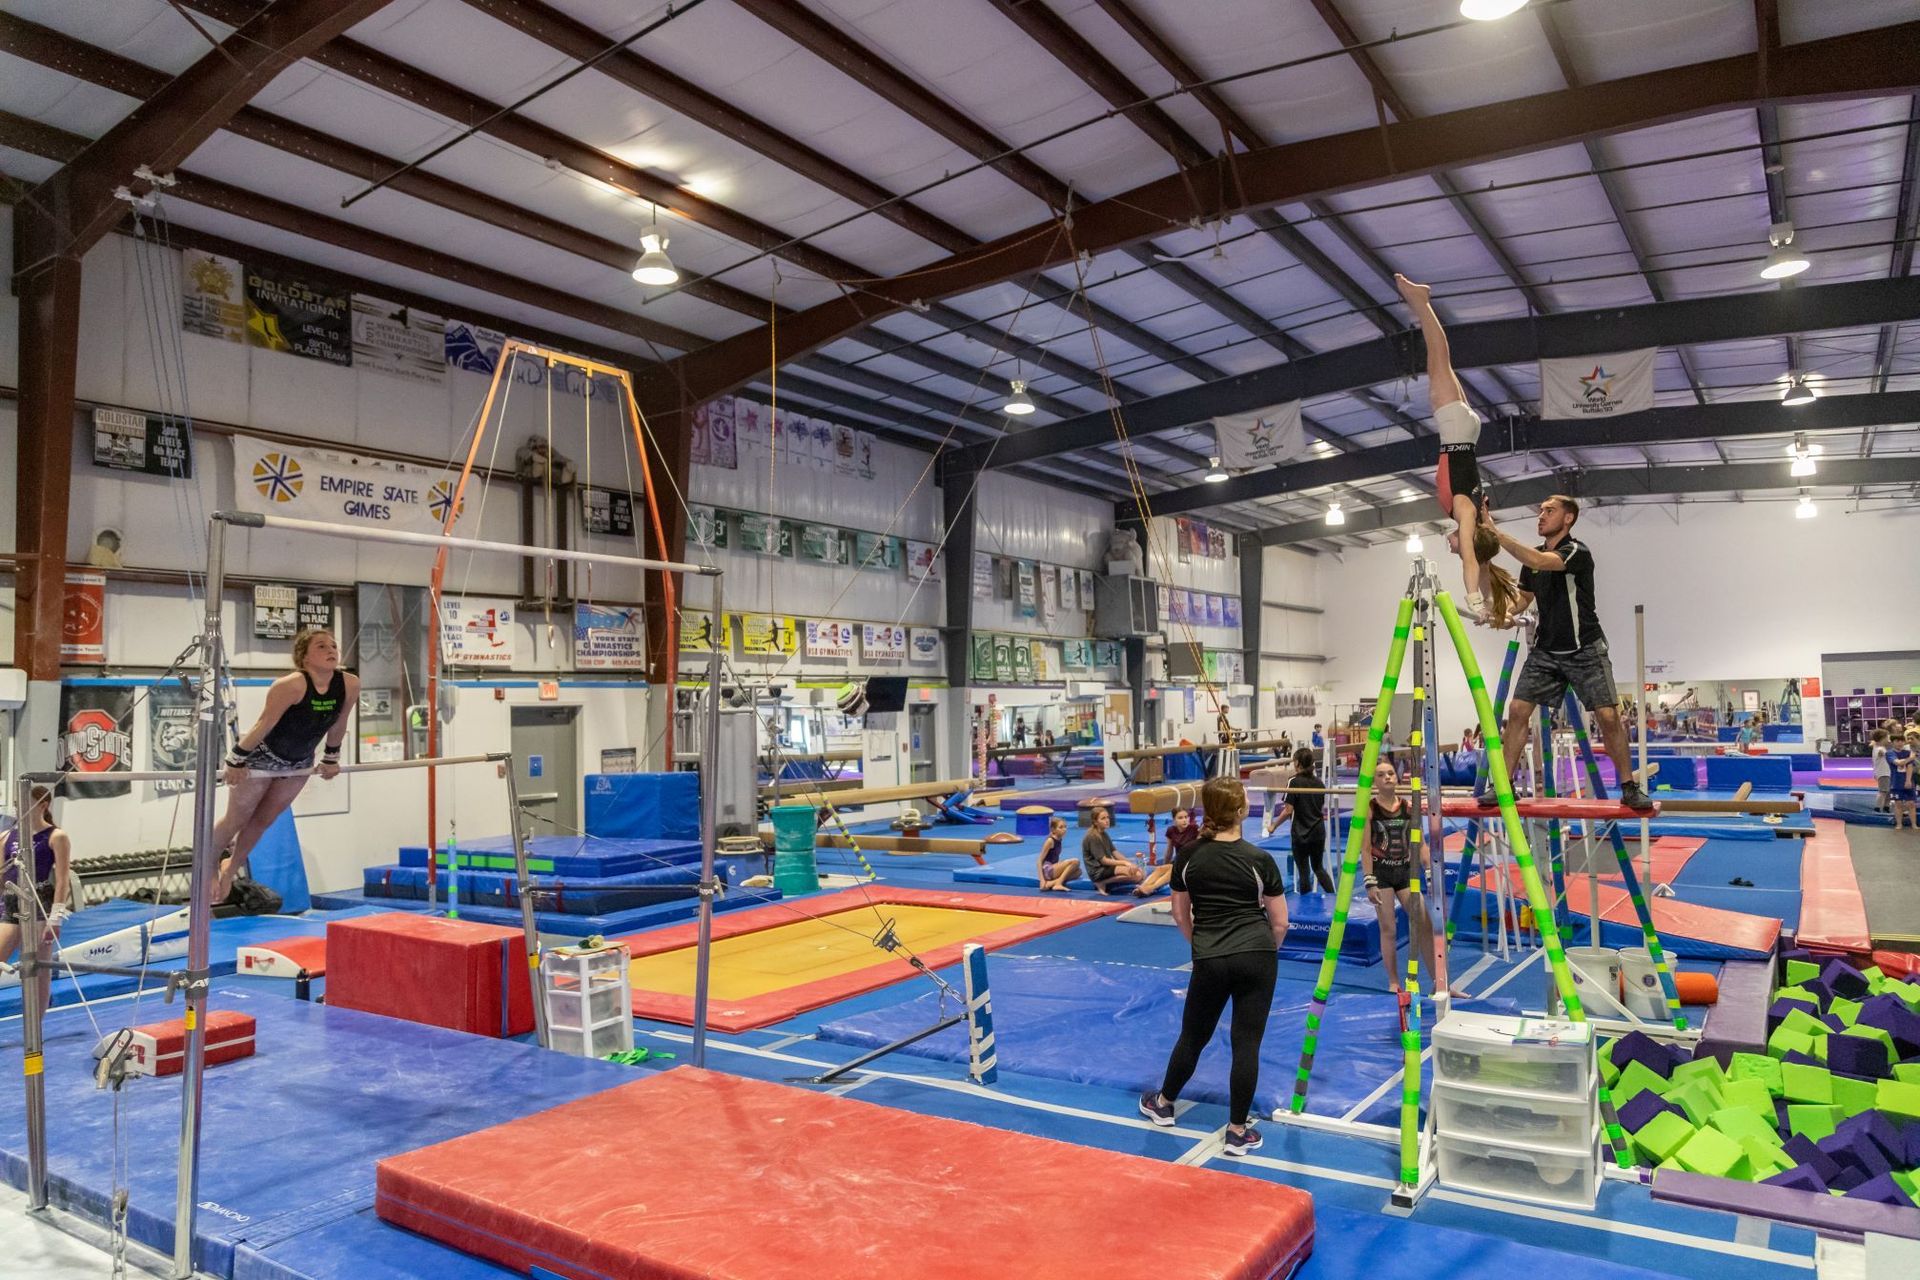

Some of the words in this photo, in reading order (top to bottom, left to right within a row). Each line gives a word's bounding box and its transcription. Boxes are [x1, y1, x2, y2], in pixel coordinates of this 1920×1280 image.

[249, 275, 347, 311] GOLDSTAR
[256, 289, 341, 320] INVITATIONAL
[302, 324, 326, 338] LEVEL
[328, 331, 338, 340] 10
[294, 343, 322, 358] PLACE
[324, 350, 347, 362] TEAM
[1572, 401, 1600, 409] University
[1600, 400, 1623, 408] Games
[97, 409, 145, 428] GOLDSTAR
[157, 435, 176, 447] LEVEL
[1446, 444, 1471, 452] NIKE
[166, 449, 186, 460] PLACE
[160, 456, 178, 469] TEAM
[320, 475, 374, 498] EMPIRE
[383, 486, 419, 504] STATE
[343, 499, 392, 520] GAMES
[256, 586, 296, 600] GOLDSTAR
[300, 603, 316, 614] LEVEL
[443, 601, 461, 610] LEVEL
[311, 614, 328, 624] PLACE
[448, 610, 458, 620] 10
[444, 624, 463, 632] THIRD
[577, 650, 641, 658] CHAMPIONSHIPS
[807, 648, 818, 656] USA
[819, 648, 853, 657] GYMNASTICS
[875, 650, 905, 659] GYMNASTICS
[1298, 924, 1330, 932] MANCINO
[89, 944, 113, 956] MMC
